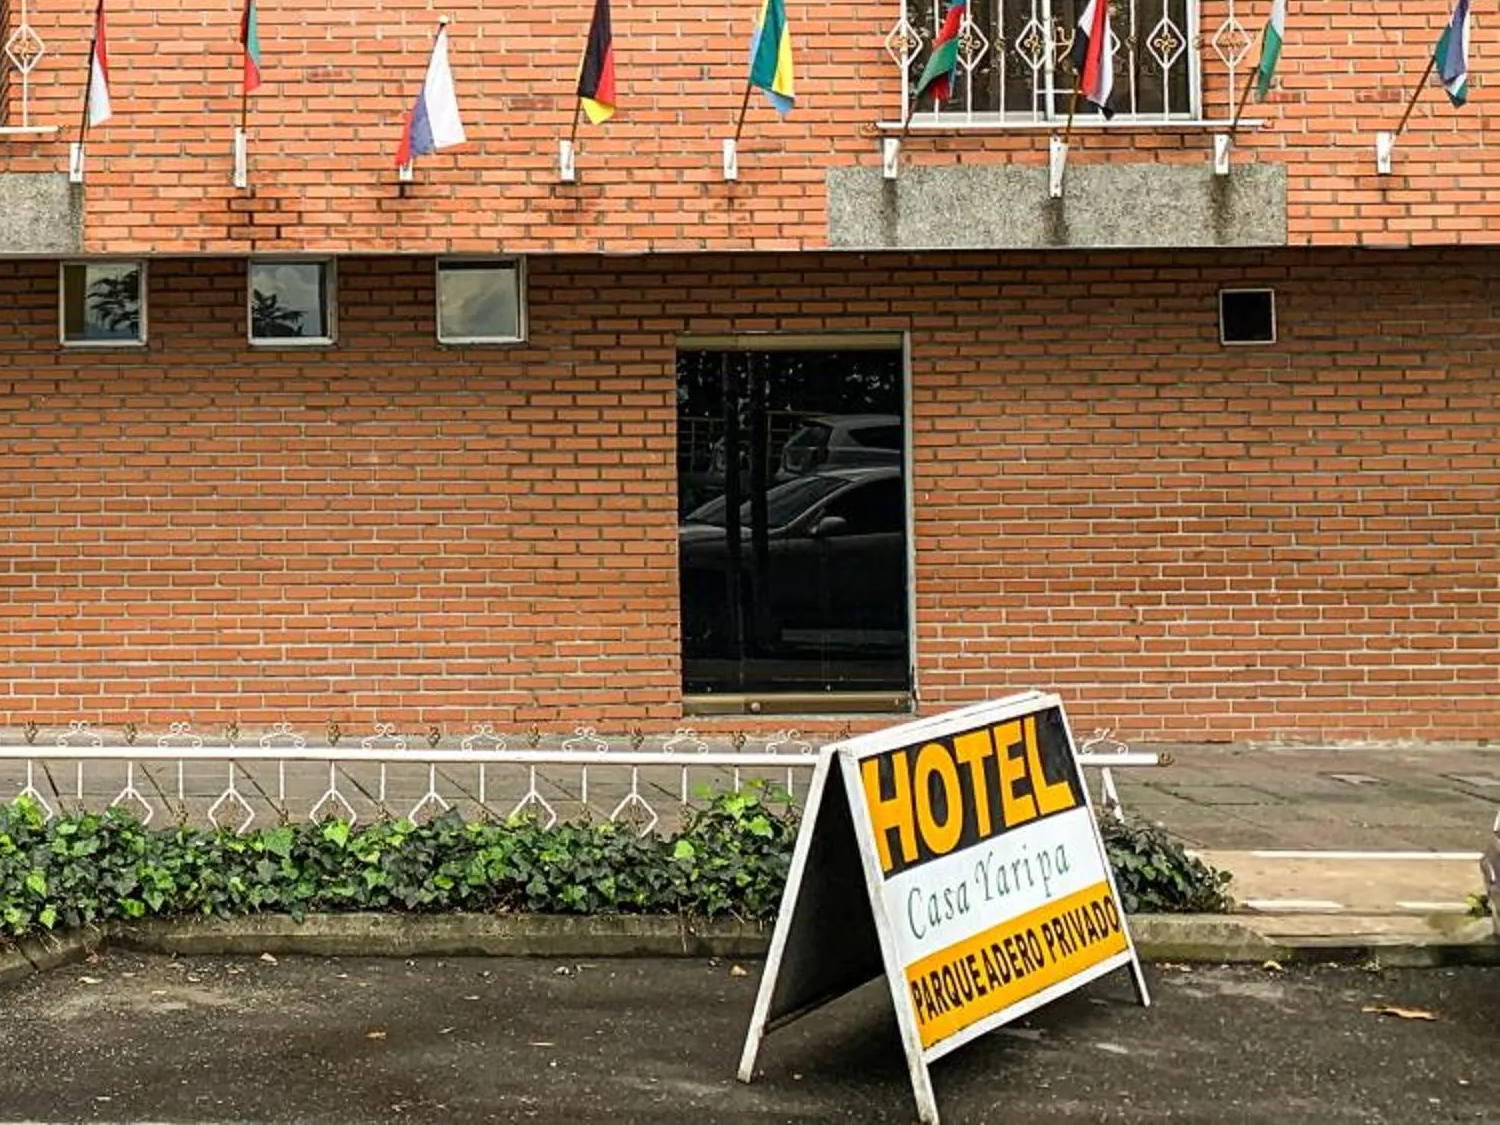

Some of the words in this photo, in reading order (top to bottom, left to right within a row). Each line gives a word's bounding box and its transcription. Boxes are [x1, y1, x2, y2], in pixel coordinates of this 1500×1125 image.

[861, 716, 1077, 873] HOTEL
[906, 878, 970, 941] Casa
[974, 843, 1071, 902] Yaripa
[910, 928, 1046, 1025] PARQUEADERO
[1041, 894, 1122, 963] PRIVADO
